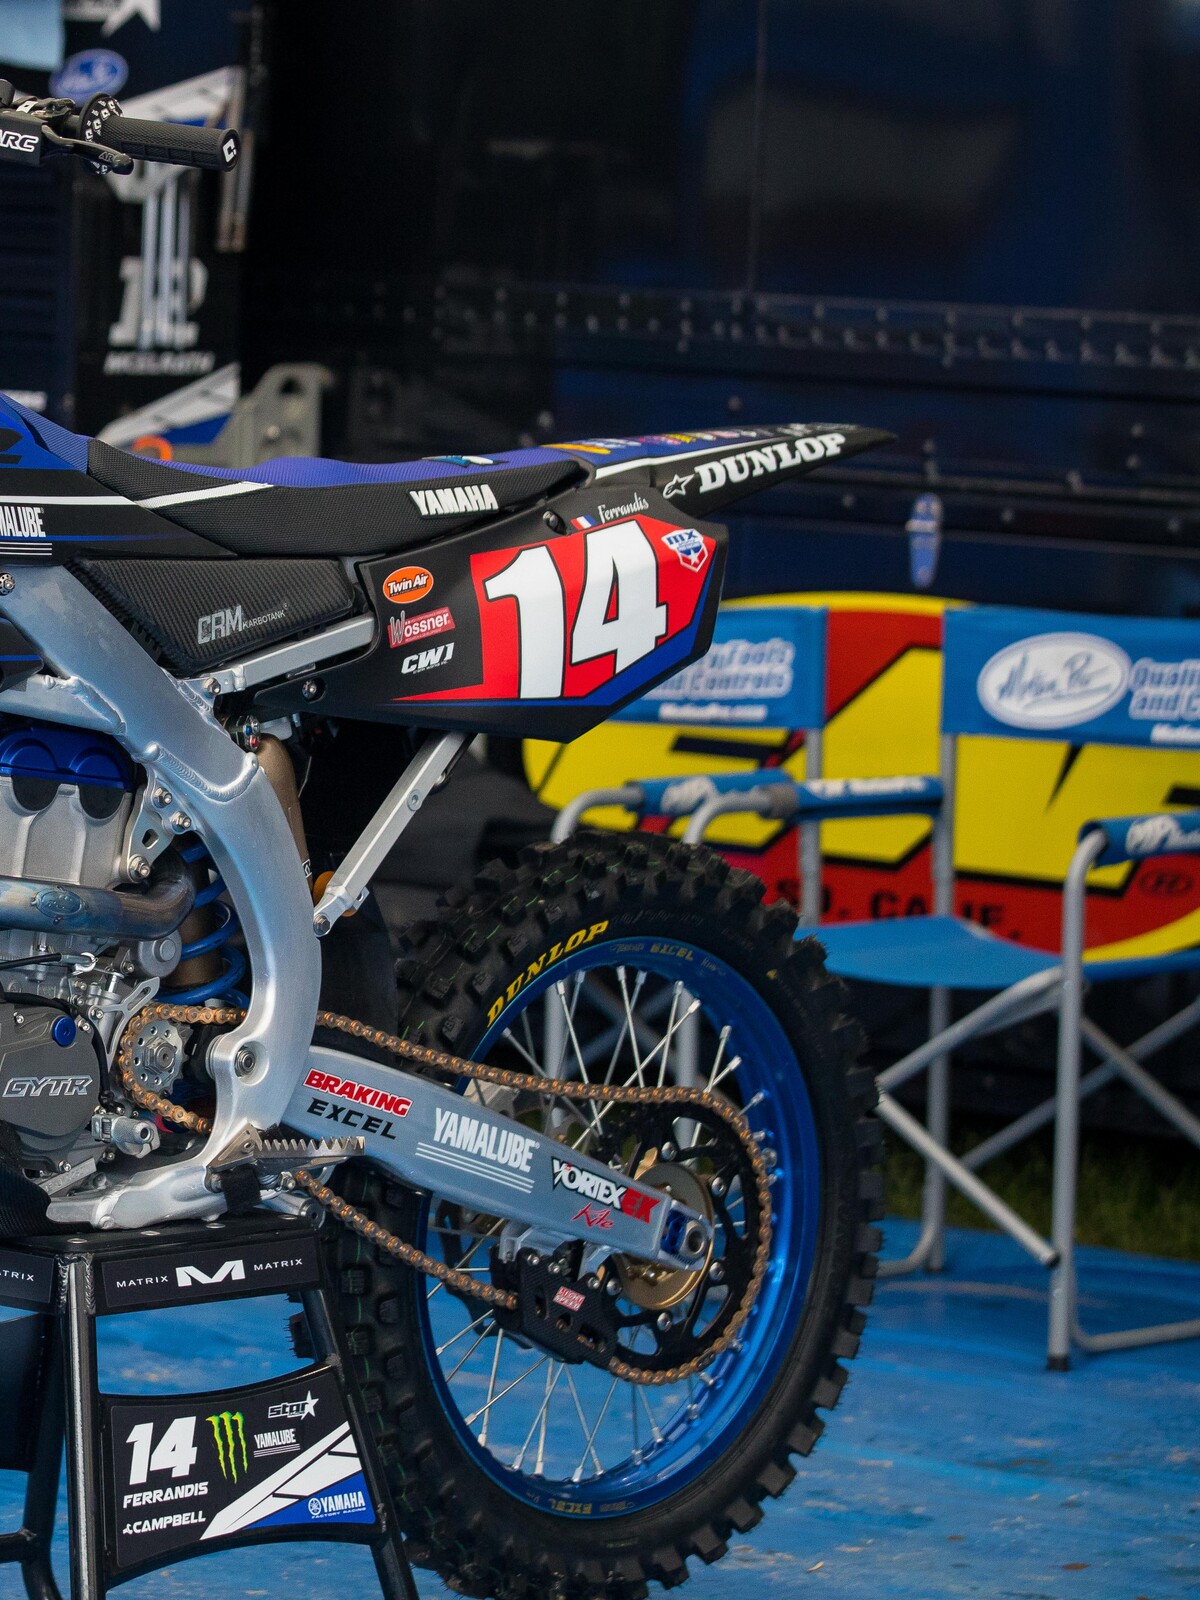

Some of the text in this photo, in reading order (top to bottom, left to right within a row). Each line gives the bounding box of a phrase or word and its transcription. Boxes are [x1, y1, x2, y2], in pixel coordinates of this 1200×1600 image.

[695, 432, 847, 494] DUNLOP
[409, 484, 499, 517] YAMAHA
[598, 491, 650, 525] Ferrandis
[388, 579, 412, 595] Twin
[413, 573, 429, 588] Air
[198, 605, 242, 644] CRM
[483, 520, 667, 699] 14
[1133, 666, 1200, 692] Quali
[487, 920, 609, 1028] DUNLOP
[2, 1074, 94, 1099] GYTR
[303, 1068, 413, 1118] BRAKING
[307, 1097, 397, 1140] EXCEL
[433, 1107, 535, 1173] YAMALUBE
[552, 1156, 627, 1211] VORTEX
[116, 1276, 169, 1288] MATRIX
[253, 1257, 303, 1272] MATRIX
[126, 1416, 198, 1485] 14
[254, 1428, 296, 1449] YAMALUBE
[123, 1481, 208, 1508] FERRANDIS
[321, 1491, 366, 1513] YAMAHA
[132, 1510, 206, 1534] CAMPBELL
[311, 1506, 367, 1520] FACTORY RACING
